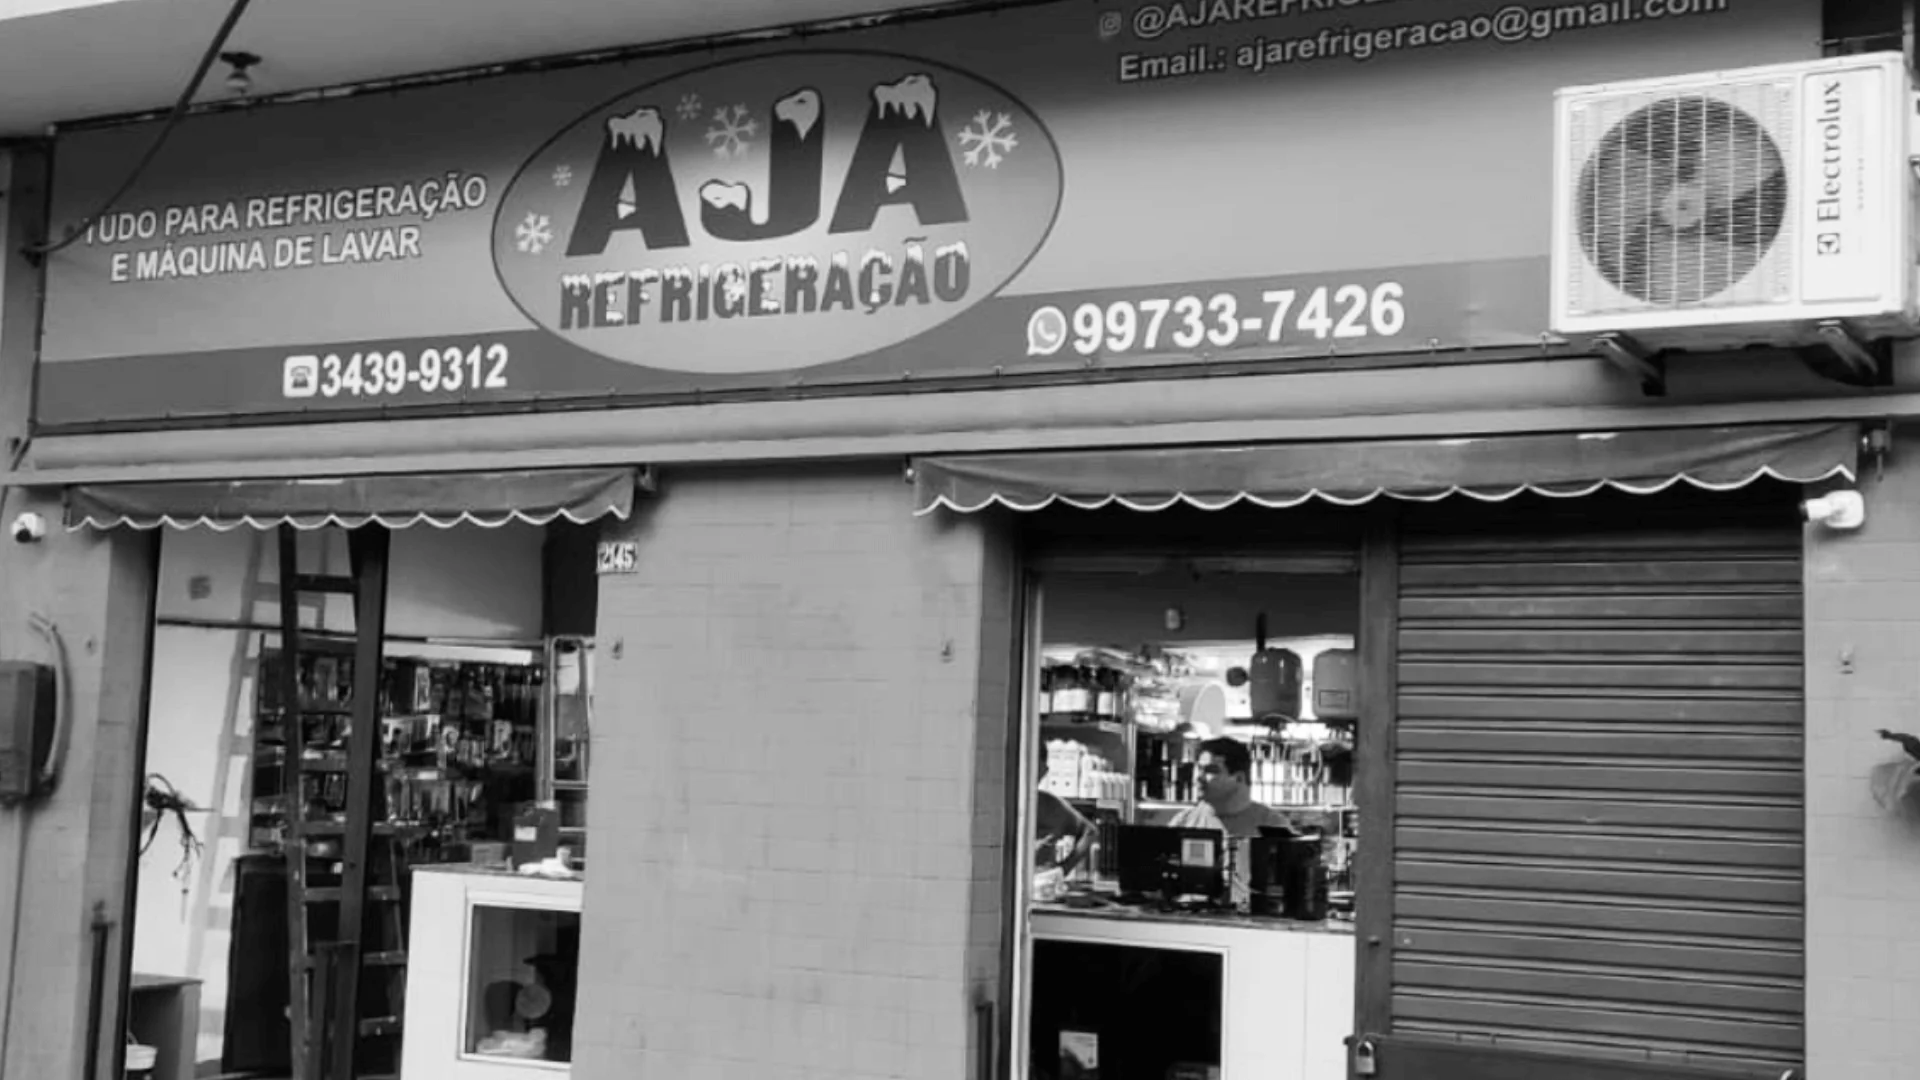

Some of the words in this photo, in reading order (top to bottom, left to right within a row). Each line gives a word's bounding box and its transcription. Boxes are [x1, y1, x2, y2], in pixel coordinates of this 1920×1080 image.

[1120, 47, 1225, 80] Email.:
[1237, 0, 1726, 71] ajarefrigeracao@gmail.com
[1133, 0, 1384, 37] @AJAREF
[565, 73, 970, 257] AJA
[1817, 81, 1842, 222] Electrolux
[165, 204, 239, 236] PARA
[246, 173, 487, 228] REFRIGERAÇÃO
[111, 252, 129, 281] E
[136, 240, 266, 279] MÁQUINA
[275, 237, 313, 269] DE
[322, 227, 420, 263] LAVAR
[560, 237, 970, 329] REFRIGERAÇÃO
[1072, 281, 1404, 354] 99733-7426
[320, 343, 508, 396] 3439-9312
